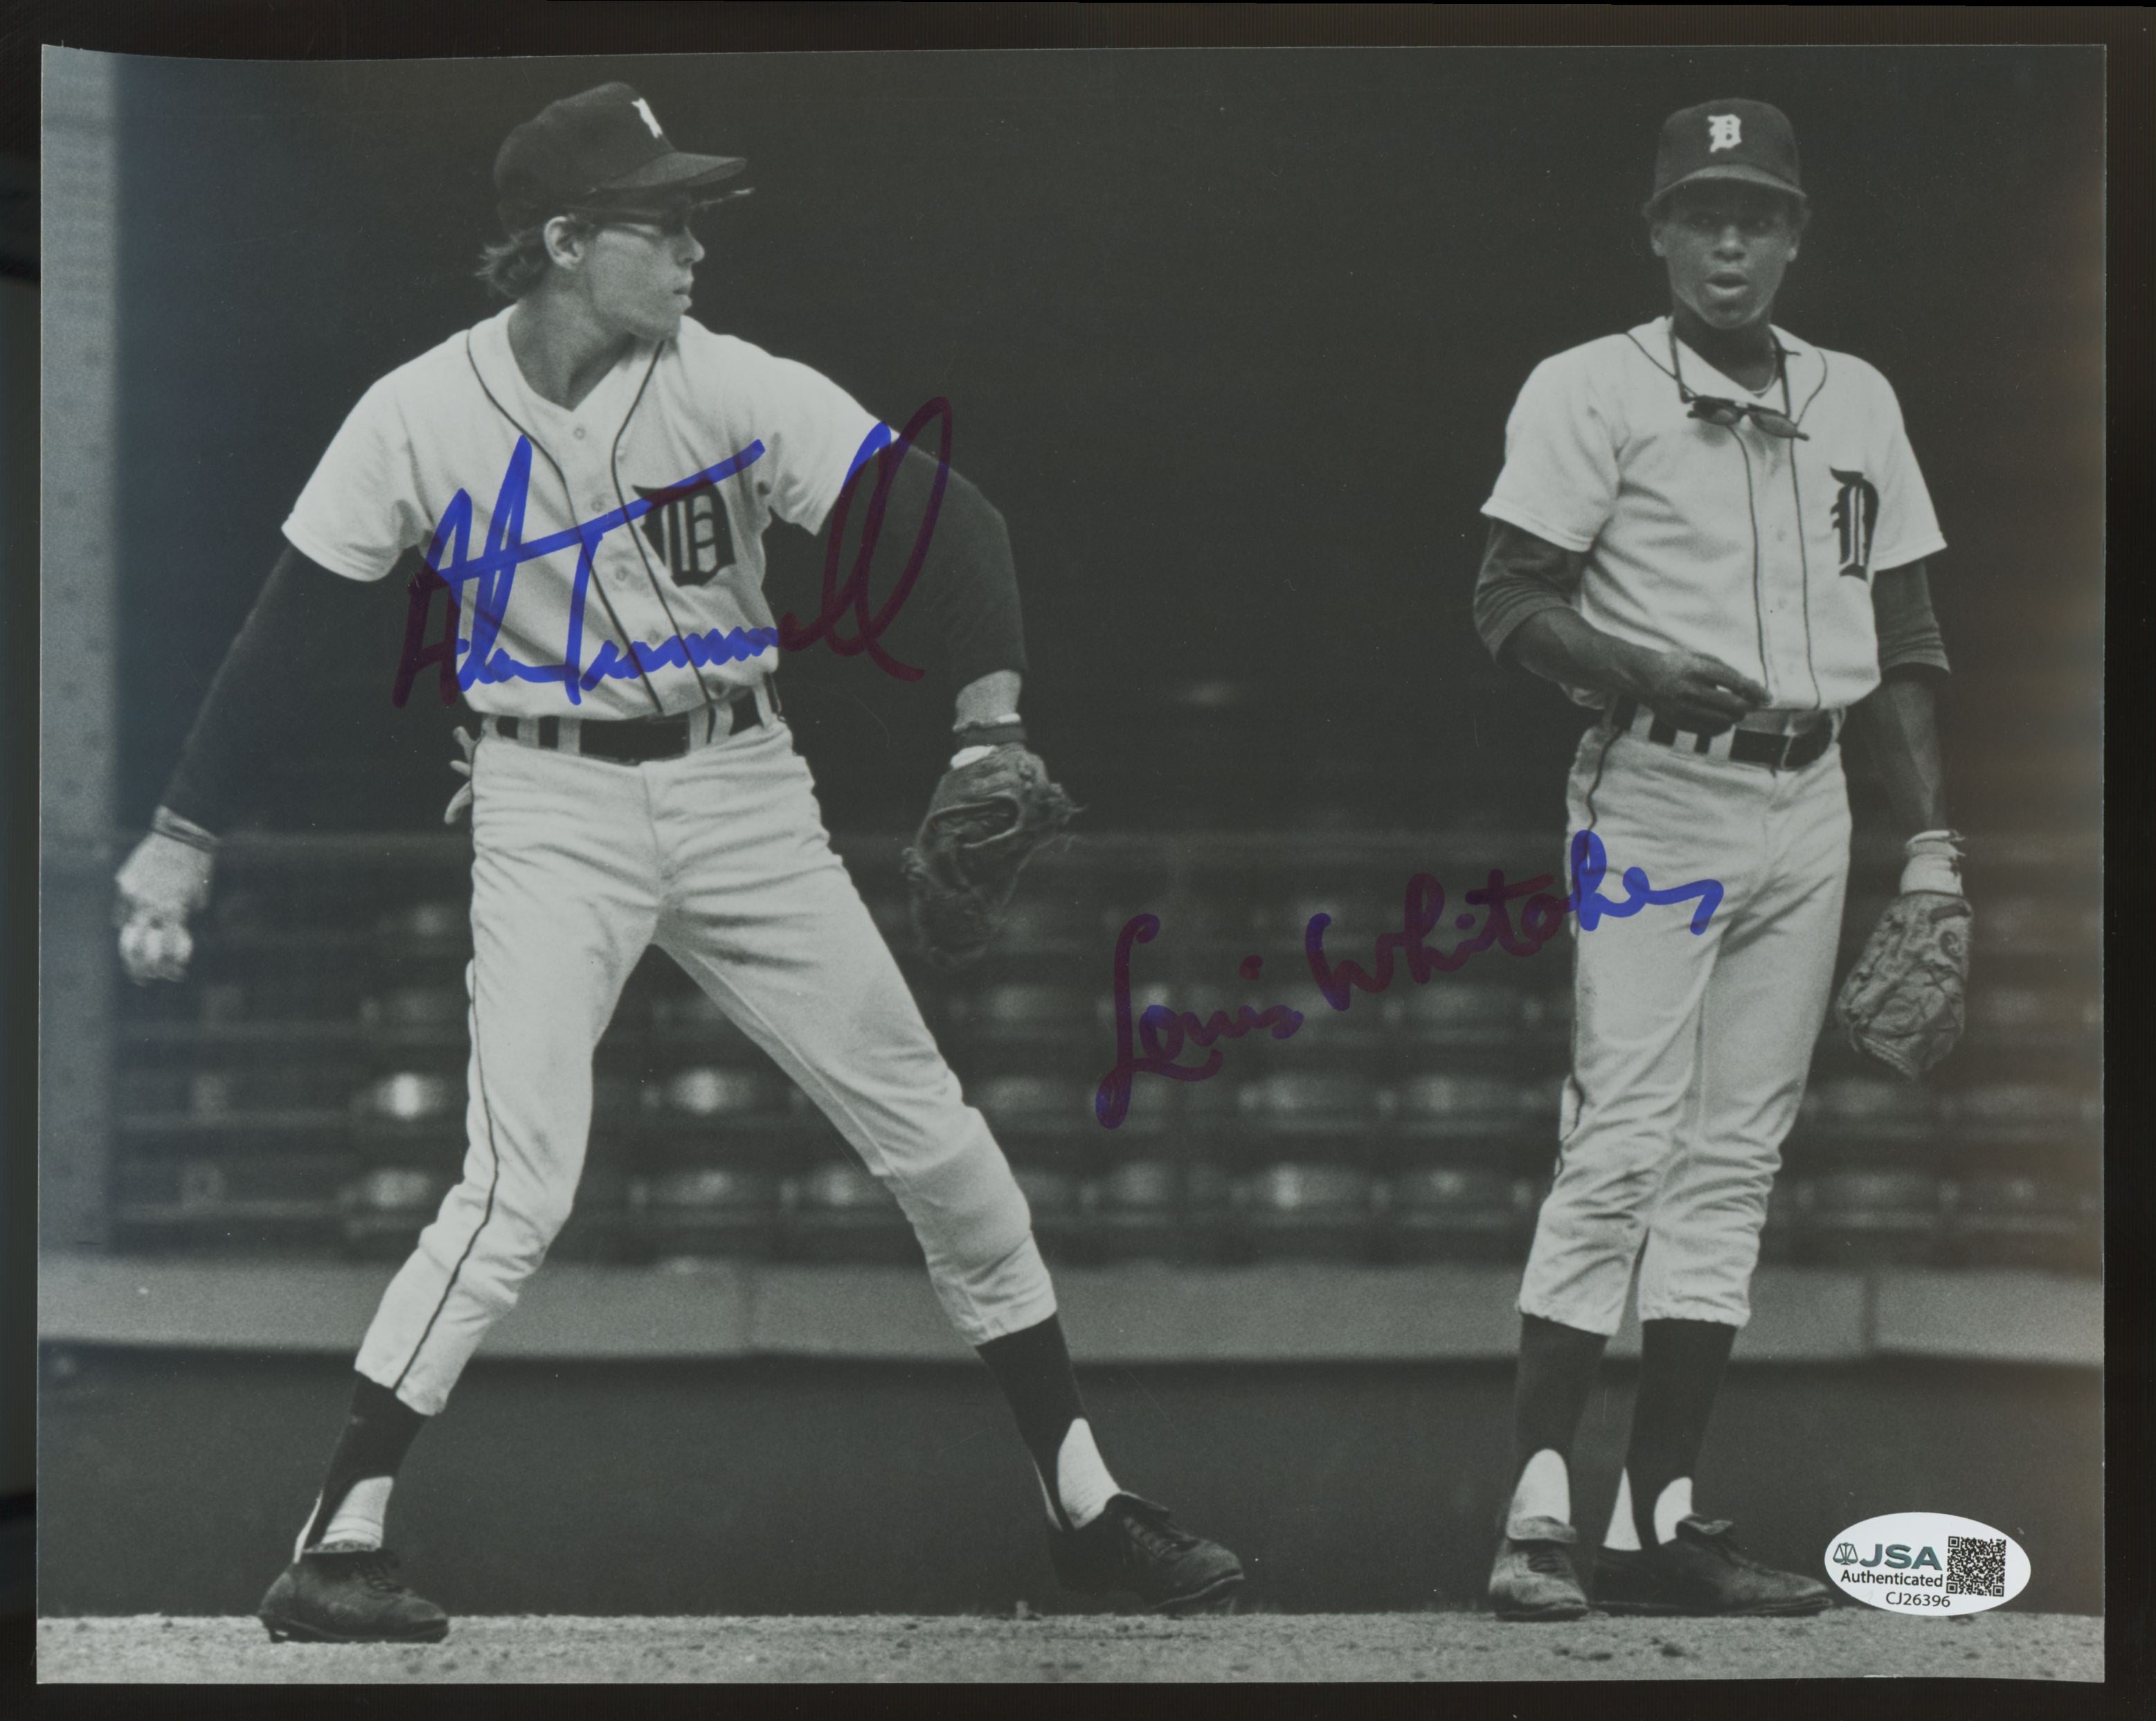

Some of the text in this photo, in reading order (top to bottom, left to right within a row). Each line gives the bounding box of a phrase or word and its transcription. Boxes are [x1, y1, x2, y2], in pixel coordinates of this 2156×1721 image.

[1707, 114, 1742, 153] D
[631, 478, 737, 587] D
[1829, 466, 1879, 582] D
[1860, 1544, 1942, 1571] JSA
[1841, 1569, 1943, 1587] Authenticated
[1885, 1592, 1951, 1607] CJ26396
